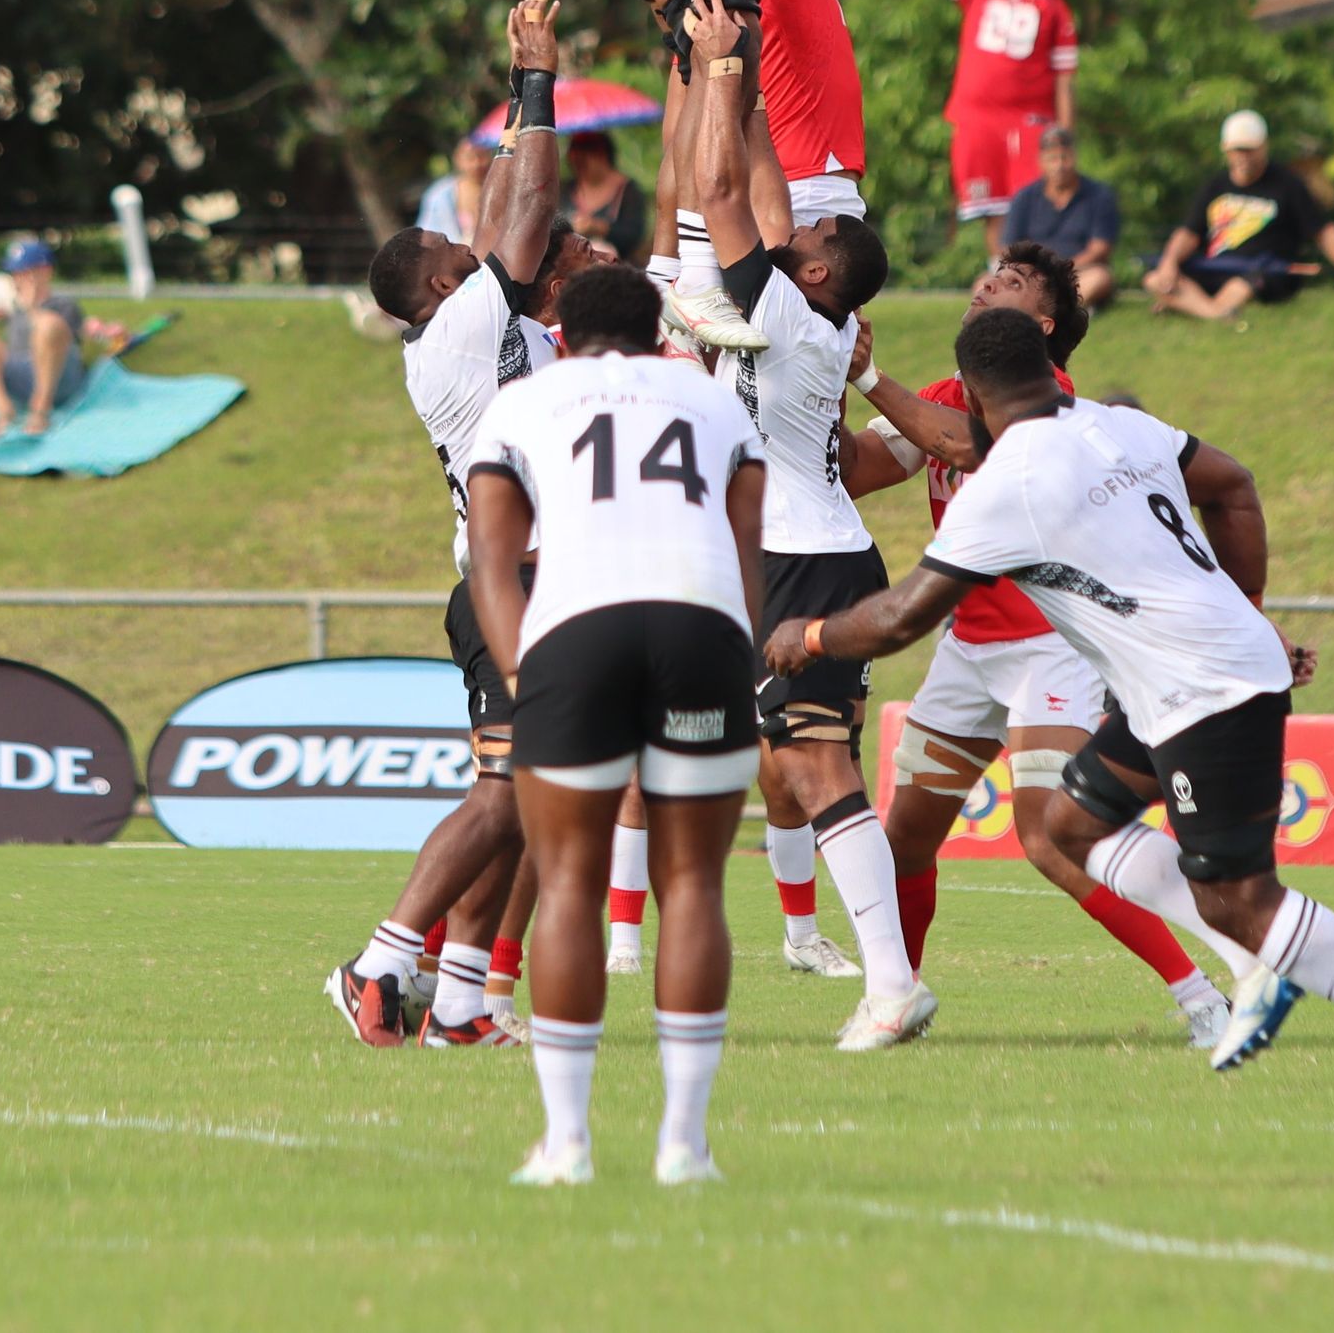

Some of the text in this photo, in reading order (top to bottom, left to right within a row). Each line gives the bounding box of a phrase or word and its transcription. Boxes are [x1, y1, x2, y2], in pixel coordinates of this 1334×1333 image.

[572, 413, 710, 508] 14
[1148, 493, 1216, 572] 8
[666, 708, 725, 727] VISION
[170, 733, 479, 790] POWER
